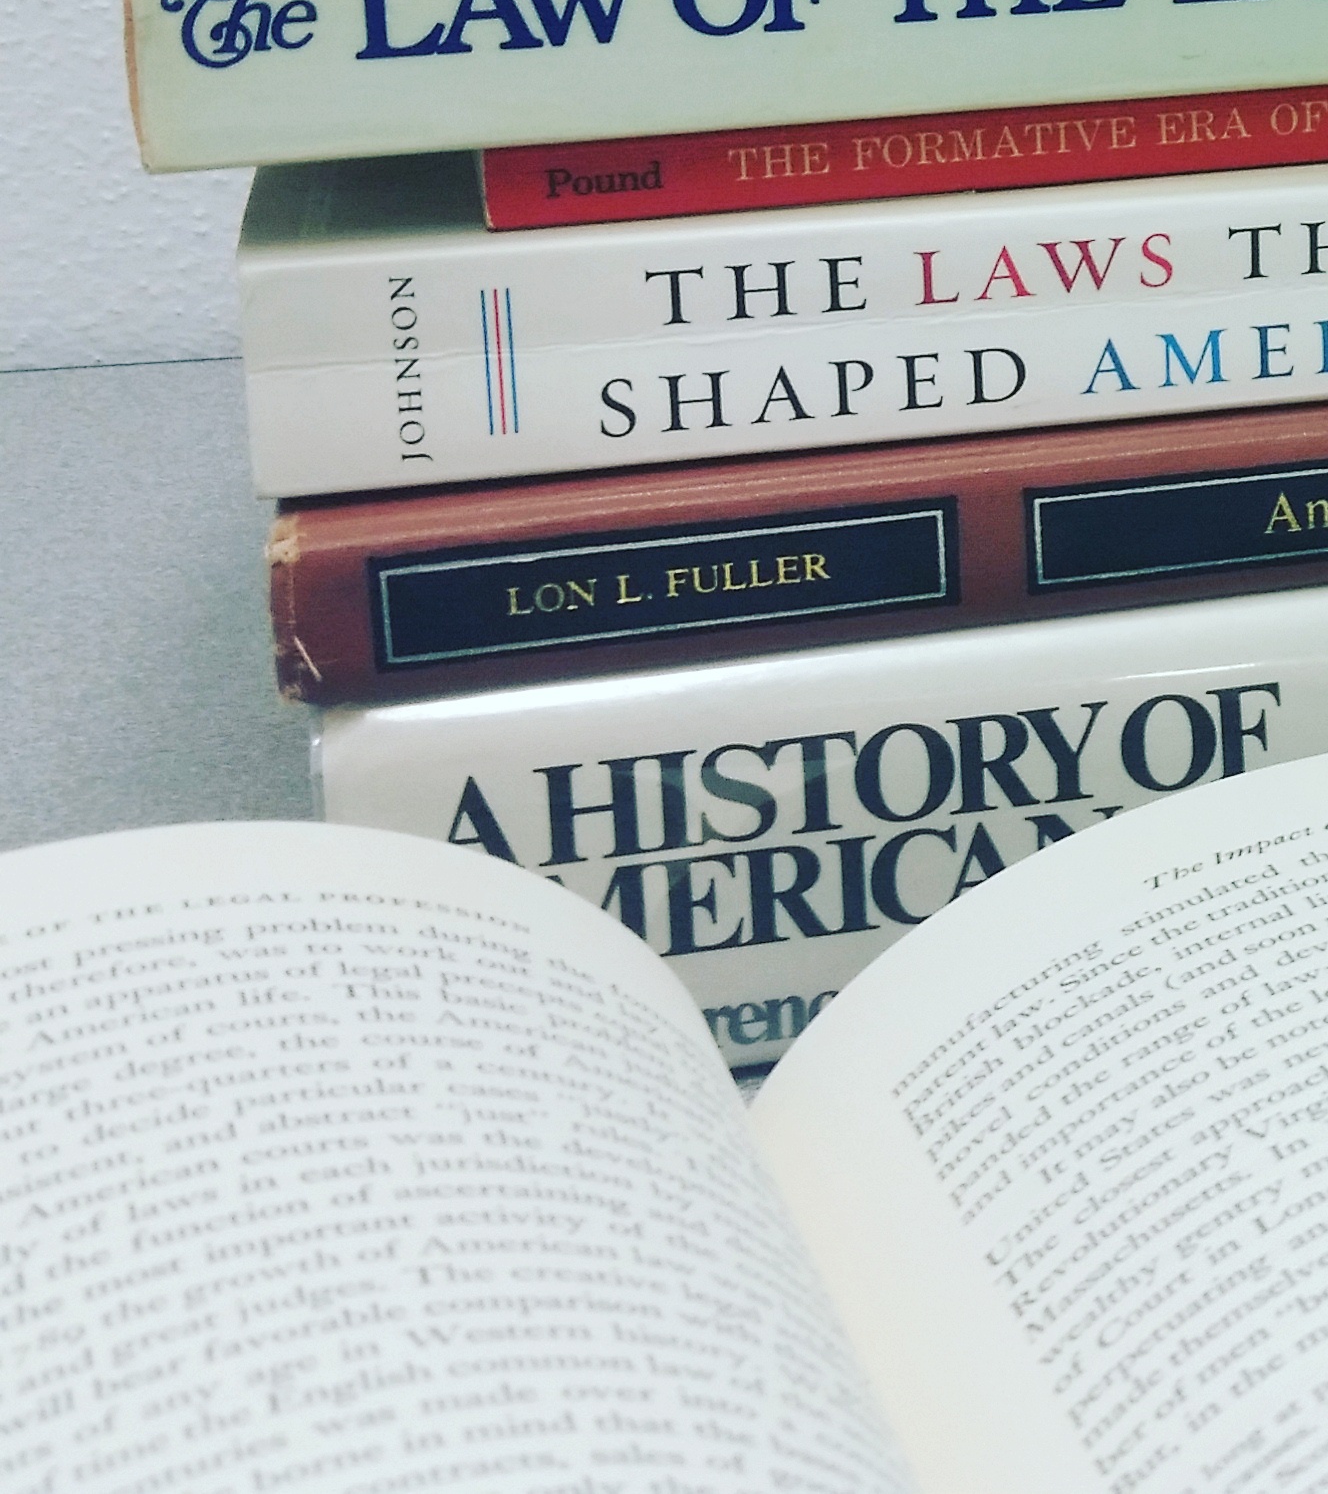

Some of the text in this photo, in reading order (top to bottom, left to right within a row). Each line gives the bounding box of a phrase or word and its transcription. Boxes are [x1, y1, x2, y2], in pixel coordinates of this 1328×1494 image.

[545, 160, 663, 199] Pound
[728, 142, 830, 183] THE
[851, 114, 1137, 172] FORMATIVE
[1158, 108, 1250, 146] ERA
[388, 274, 434, 463] JOHNSON
[645, 254, 868, 327] THE
[914, 232, 1174, 306] LAWS
[599, 345, 1027, 439] SHAPED
[506, 552, 832, 616] LON L. FULLER
[446, 682, 1284, 869] A HISTORY OF
[1143, 861, 1204, 891] The
[1214, 827, 1315, 866] Impact
[890, 940, 1103, 1098] manufacturing
[1120, 864, 1280, 938] stimulated
[901, 1037, 987, 1122] patent
[991, 996, 1056, 1040] law.
[1058, 942, 1144, 995] Since
[1150, 920, 1200, 949] the
[912, 1055, 1004, 1139] British
[1013, 965, 1163, 1051] blockade,
[1171, 905, 1295, 962] internal
[925, 1089, 998, 1165] pikes
[998, 1045, 1056, 1093] and
[1060, 988, 1156, 1048] canals
[1164, 946, 1241, 993] (and
[1242, 919, 1318, 957] soon
[935, 1104, 1015, 1182] novel
[1024, 998, 1188, 1102] conditions
[1202, 963, 1260, 999] and
[949, 1104, 1052, 1209] panded
[1060, 1067, 1112, 1106] the
[1120, 1016, 1210, 1069] range
[1219, 992, 1251, 1015] of
